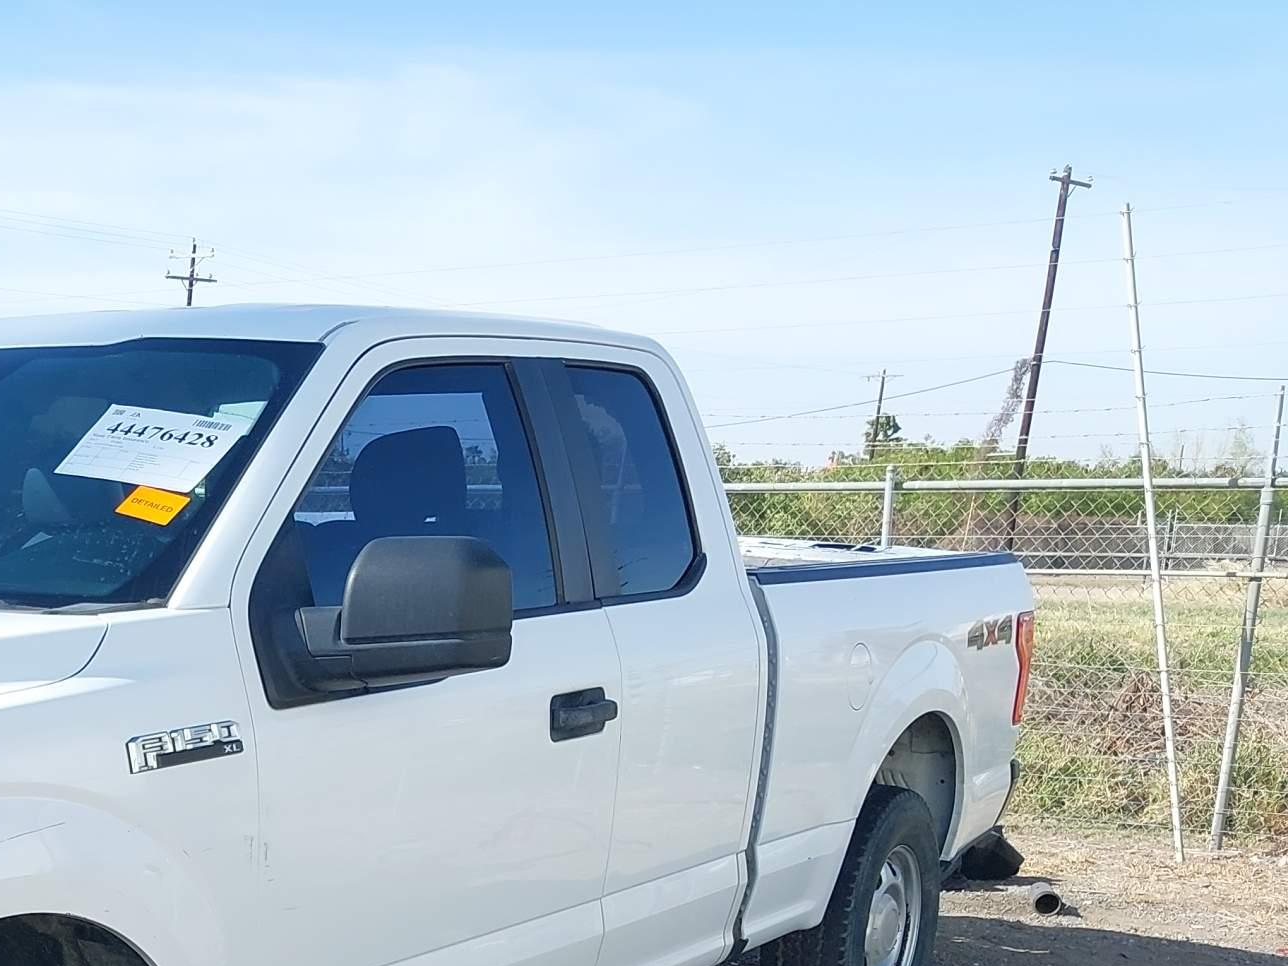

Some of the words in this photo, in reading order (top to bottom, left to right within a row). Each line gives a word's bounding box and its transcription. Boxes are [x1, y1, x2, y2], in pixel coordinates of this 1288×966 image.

[106, 421, 219, 449] 44476428
[130, 496, 174, 514] DETAILED
[223, 743, 242, 753] XL
